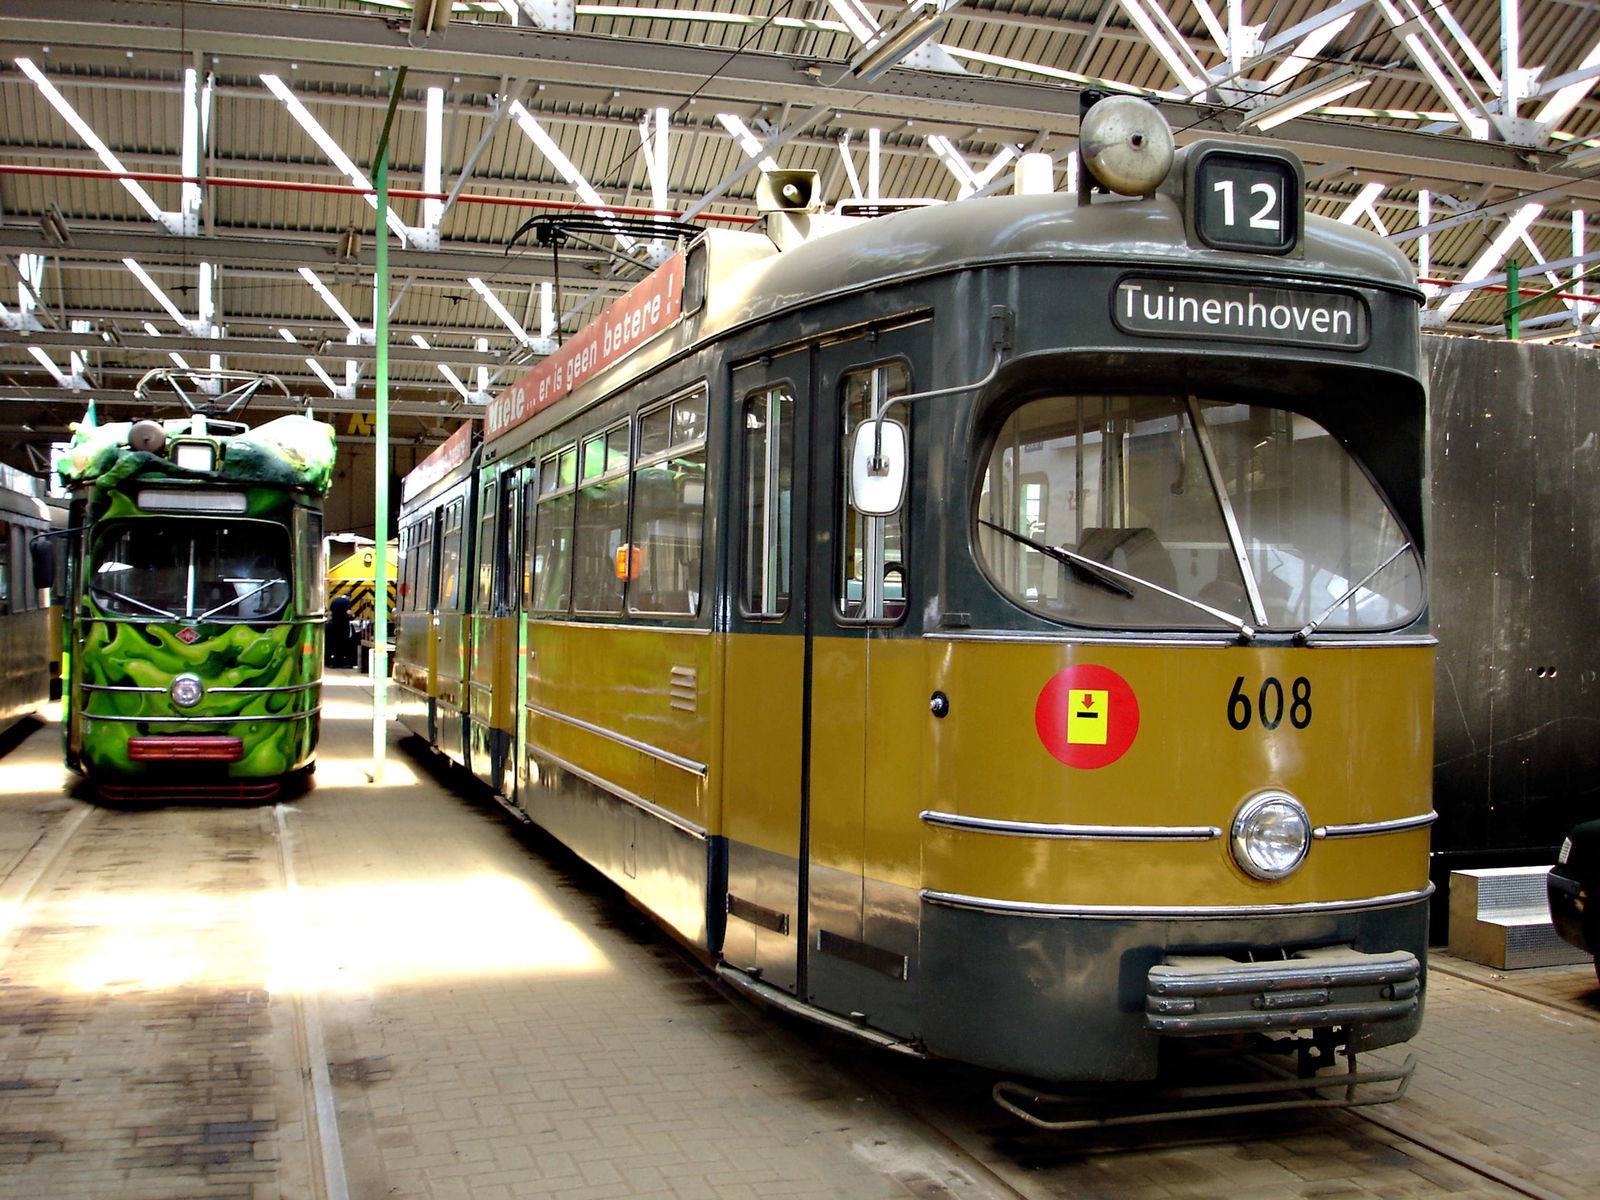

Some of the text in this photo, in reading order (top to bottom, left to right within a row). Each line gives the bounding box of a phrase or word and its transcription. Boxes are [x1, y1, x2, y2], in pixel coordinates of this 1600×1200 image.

[1213, 180, 1280, 230] 12
[1118, 284, 1352, 335] Tuinenhoven
[539, 375, 551, 402] er
[553, 362, 563, 392] is
[566, 340, 598, 392] geen
[1226, 676, 1312, 731] 608
